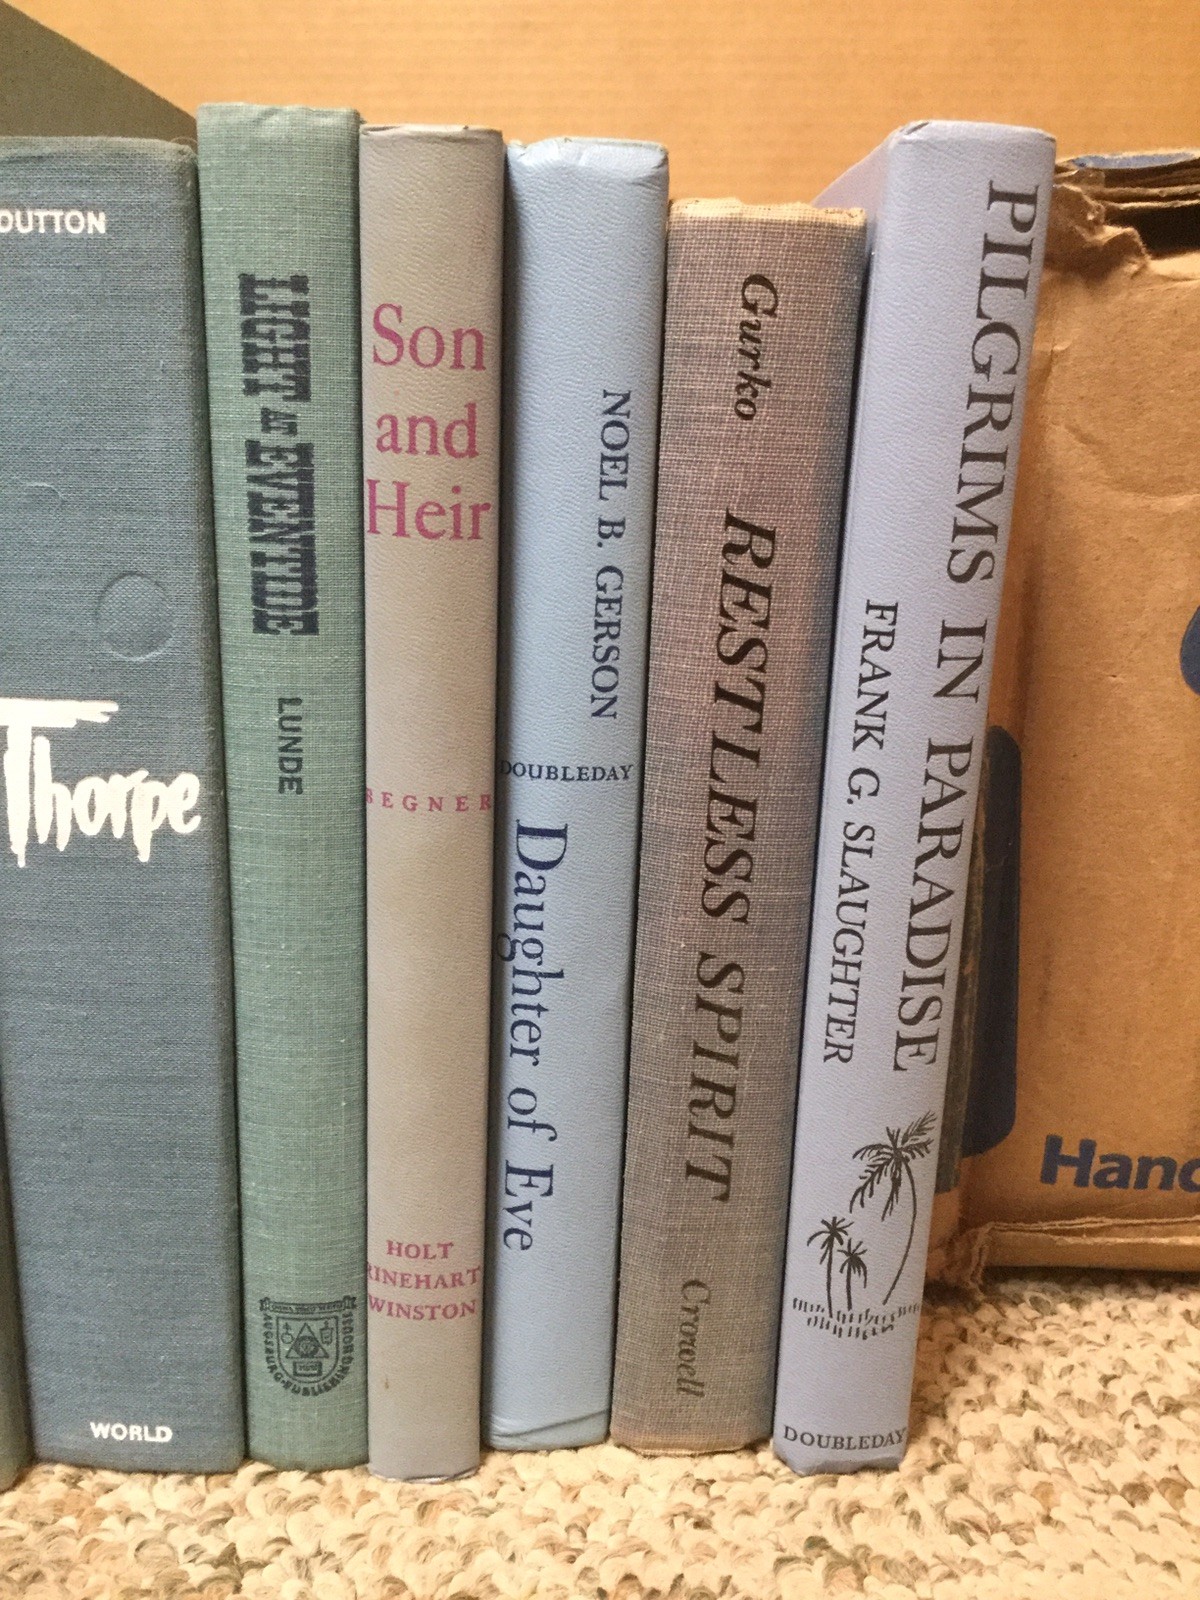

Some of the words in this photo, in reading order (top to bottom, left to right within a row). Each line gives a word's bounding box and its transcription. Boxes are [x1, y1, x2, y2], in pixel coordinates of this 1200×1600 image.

[0, 208, 106, 234] DUTTON
[238, 272, 312, 403] LIGHT
[372, 302, 487, 371] Son
[734, 274, 779, 421] Gurko
[946, 180, 1039, 585] PILGRIMS
[260, 406, 299, 436] AT
[375, 401, 480, 460] and
[598, 388, 632, 502] NOEL
[245, 439, 319, 635] EVENTIDE
[366, 478, 492, 541] Heir
[596, 516, 627, 549] B.
[590, 564, 625, 720] GERSON
[851, 598, 899, 752] FRANK
[932, 619, 988, 704] IN
[277, 696, 303, 796] LUNDE
[701, 506, 778, 925] RESTLESS
[0, 696, 201, 868] Thorpe
[499, 759, 634, 782] DOUBLEDAY
[847, 766, 880, 805] G.
[497, 818, 568, 1067] Daughter
[823, 820, 877, 1065] SLAUGHTER
[893, 736, 974, 1073] PARADISE
[506, 1086, 558, 1143] of
[685, 950, 746, 1203] SPIRIT
[386, 1239, 455, 1260] HOLT
[502, 1159, 554, 1251] Eve
[368, 1292, 477, 1321] WINSTON
[676, 1279, 711, 1398] Crowell
[89, 1421, 173, 1444] WORLD
[783, 1424, 908, 1451] DOUBLEDAY
